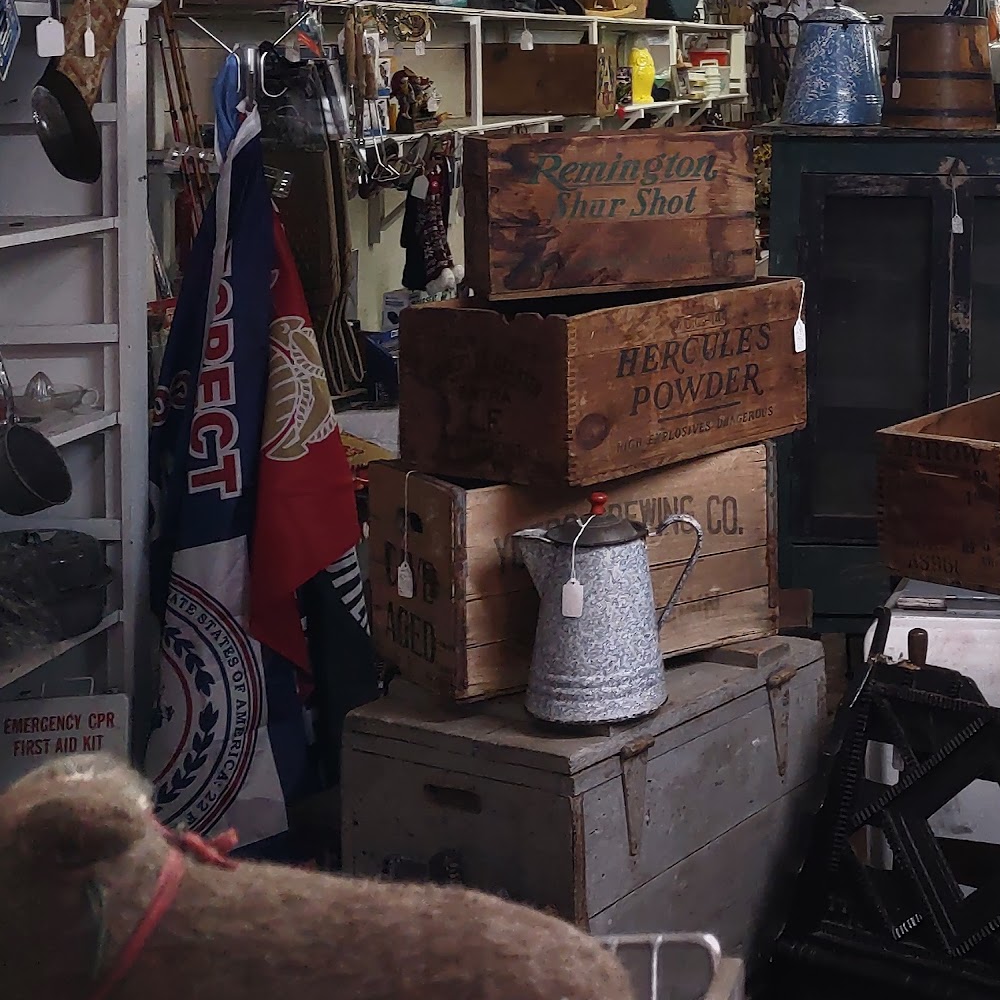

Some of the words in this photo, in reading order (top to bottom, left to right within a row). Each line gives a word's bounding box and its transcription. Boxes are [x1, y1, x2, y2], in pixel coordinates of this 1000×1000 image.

[529, 152, 718, 191] Remington
[554, 191, 626, 219] Shur
[629, 186, 698, 217] Shot
[616, 323, 771, 378] HERCULES
[629, 363, 764, 416] POWDER
[706, 494, 744, 536] CO.
[198, 613, 241, 668] STATES
[231, 671, 247, 693] OF
[4, 713, 82, 735] EMERGENCY
[88, 711, 116, 730] CPR
[13, 738, 51, 757] FIRST
[55, 736, 77, 754] AID
[82, 734, 104, 752] KIT
